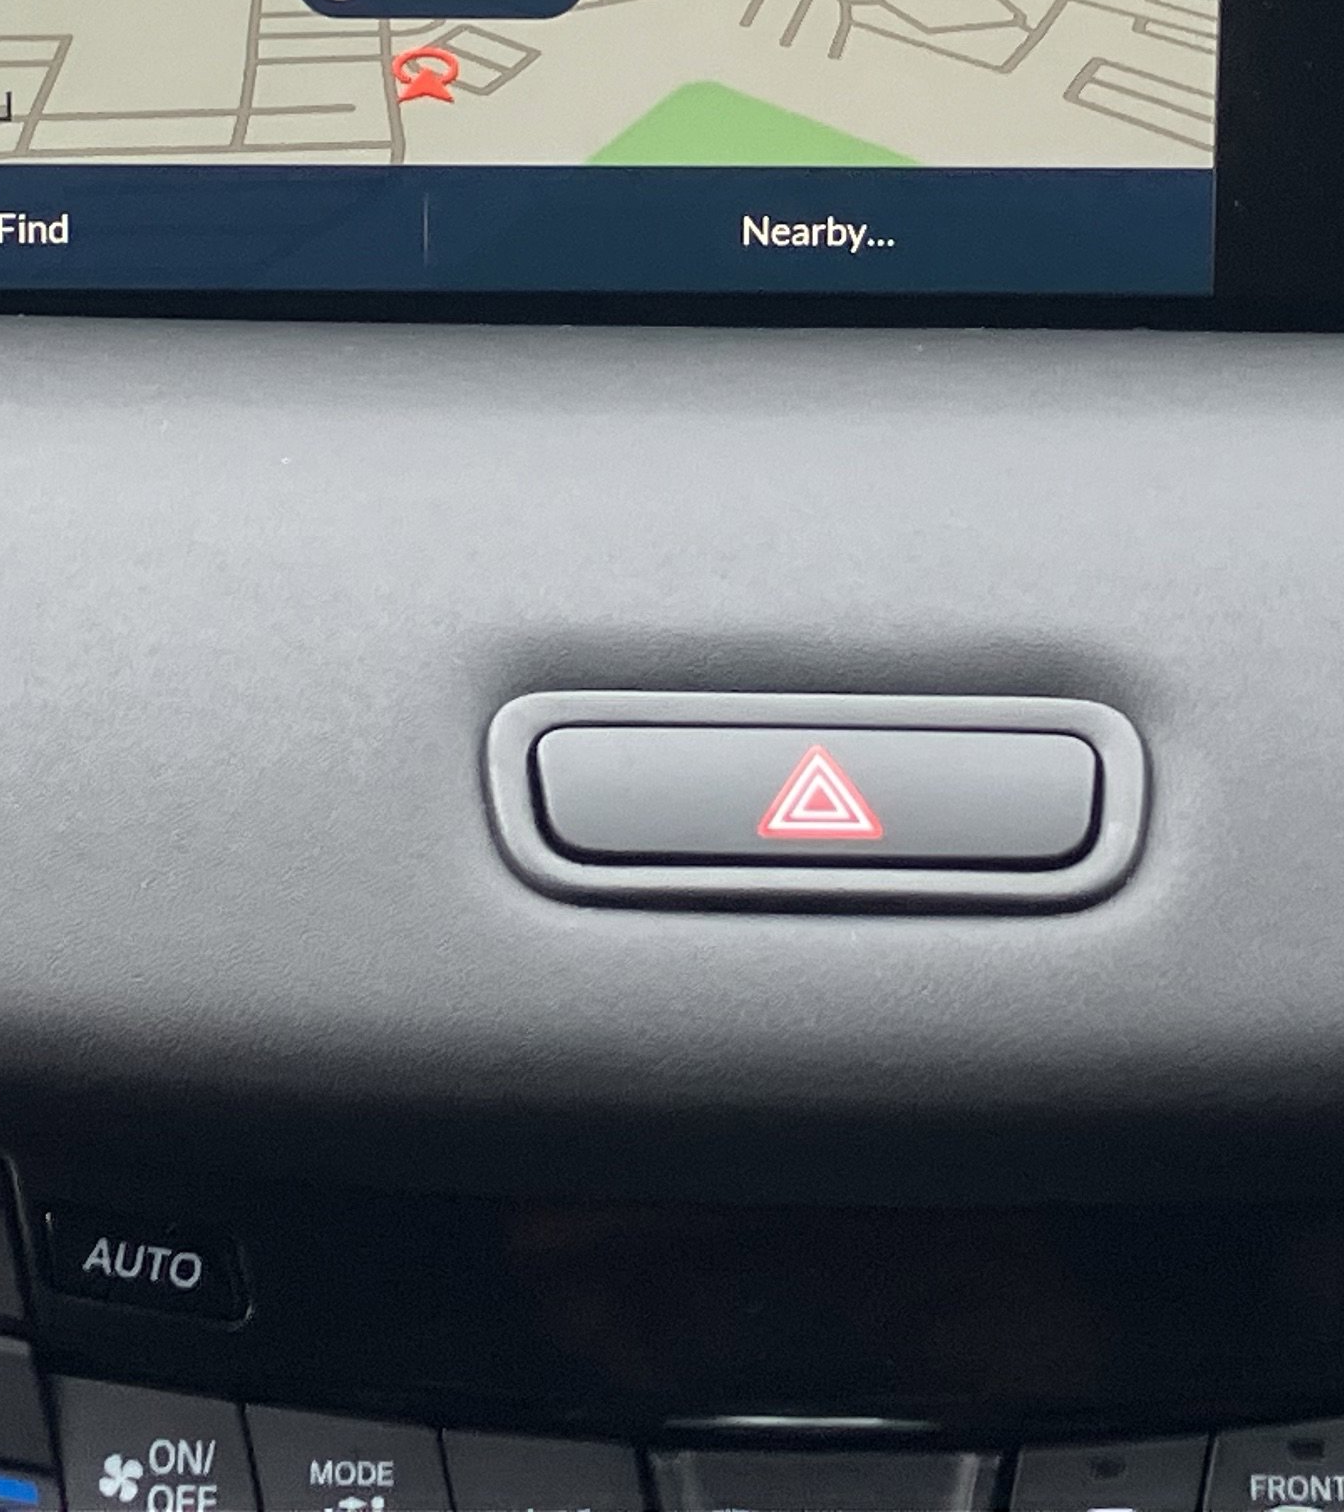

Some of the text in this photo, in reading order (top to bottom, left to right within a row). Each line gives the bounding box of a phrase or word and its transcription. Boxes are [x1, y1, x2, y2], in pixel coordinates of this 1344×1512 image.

[741, 215, 896, 255] Nearby...
[81, 1237, 203, 1288] AUTO
[148, 1438, 217, 1475] ON/
[309, 1459, 395, 1487] MODE
[147, 1484, 218, 1512] OFF
